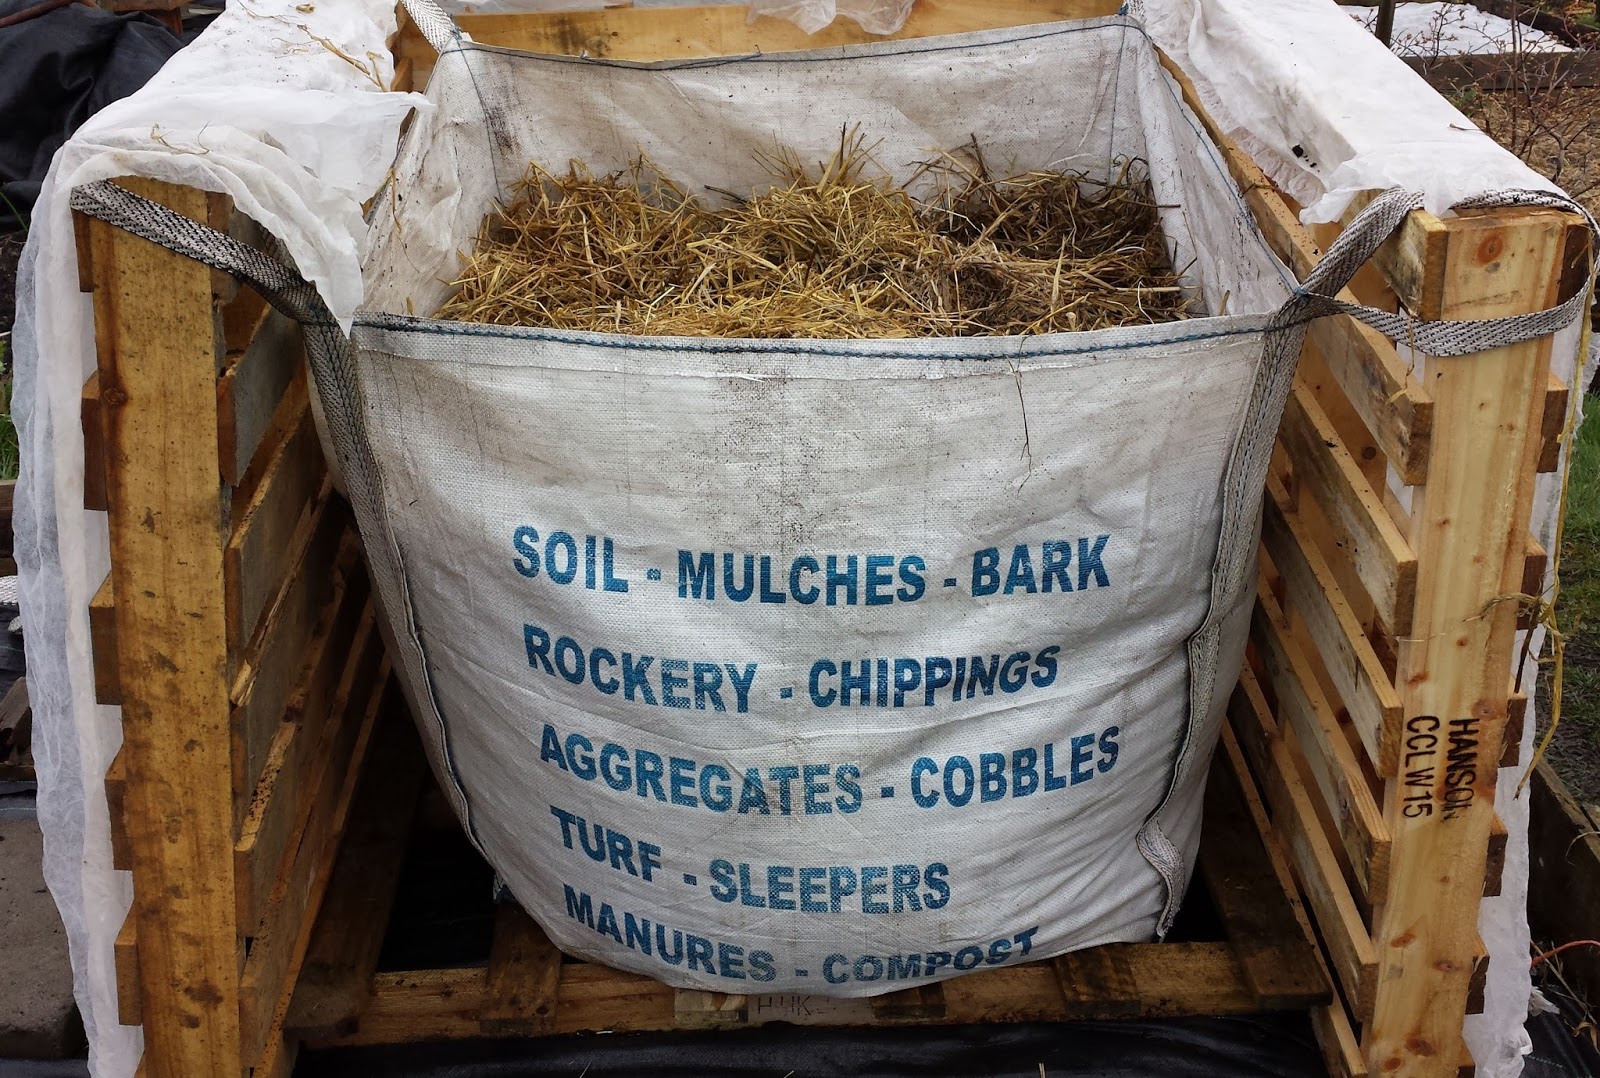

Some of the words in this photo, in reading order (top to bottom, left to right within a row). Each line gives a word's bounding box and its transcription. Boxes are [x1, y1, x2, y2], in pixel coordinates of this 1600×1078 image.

[512, 525, 629, 593] SOIL
[678, 550, 926, 606] MULCHES
[971, 534, 1111, 597] BARK
[523, 623, 759, 713] ROCKERY
[809, 645, 1060, 708] CHIPPINGS
[540, 723, 863, 816] AGGREGATES
[910, 726, 1120, 809] COBBLES
[550, 805, 662, 883] TURF
[709, 858, 952, 914] SLEEPERS
[563, 883, 777, 983] MANURES
[822, 926, 1040, 984] COMPOST
